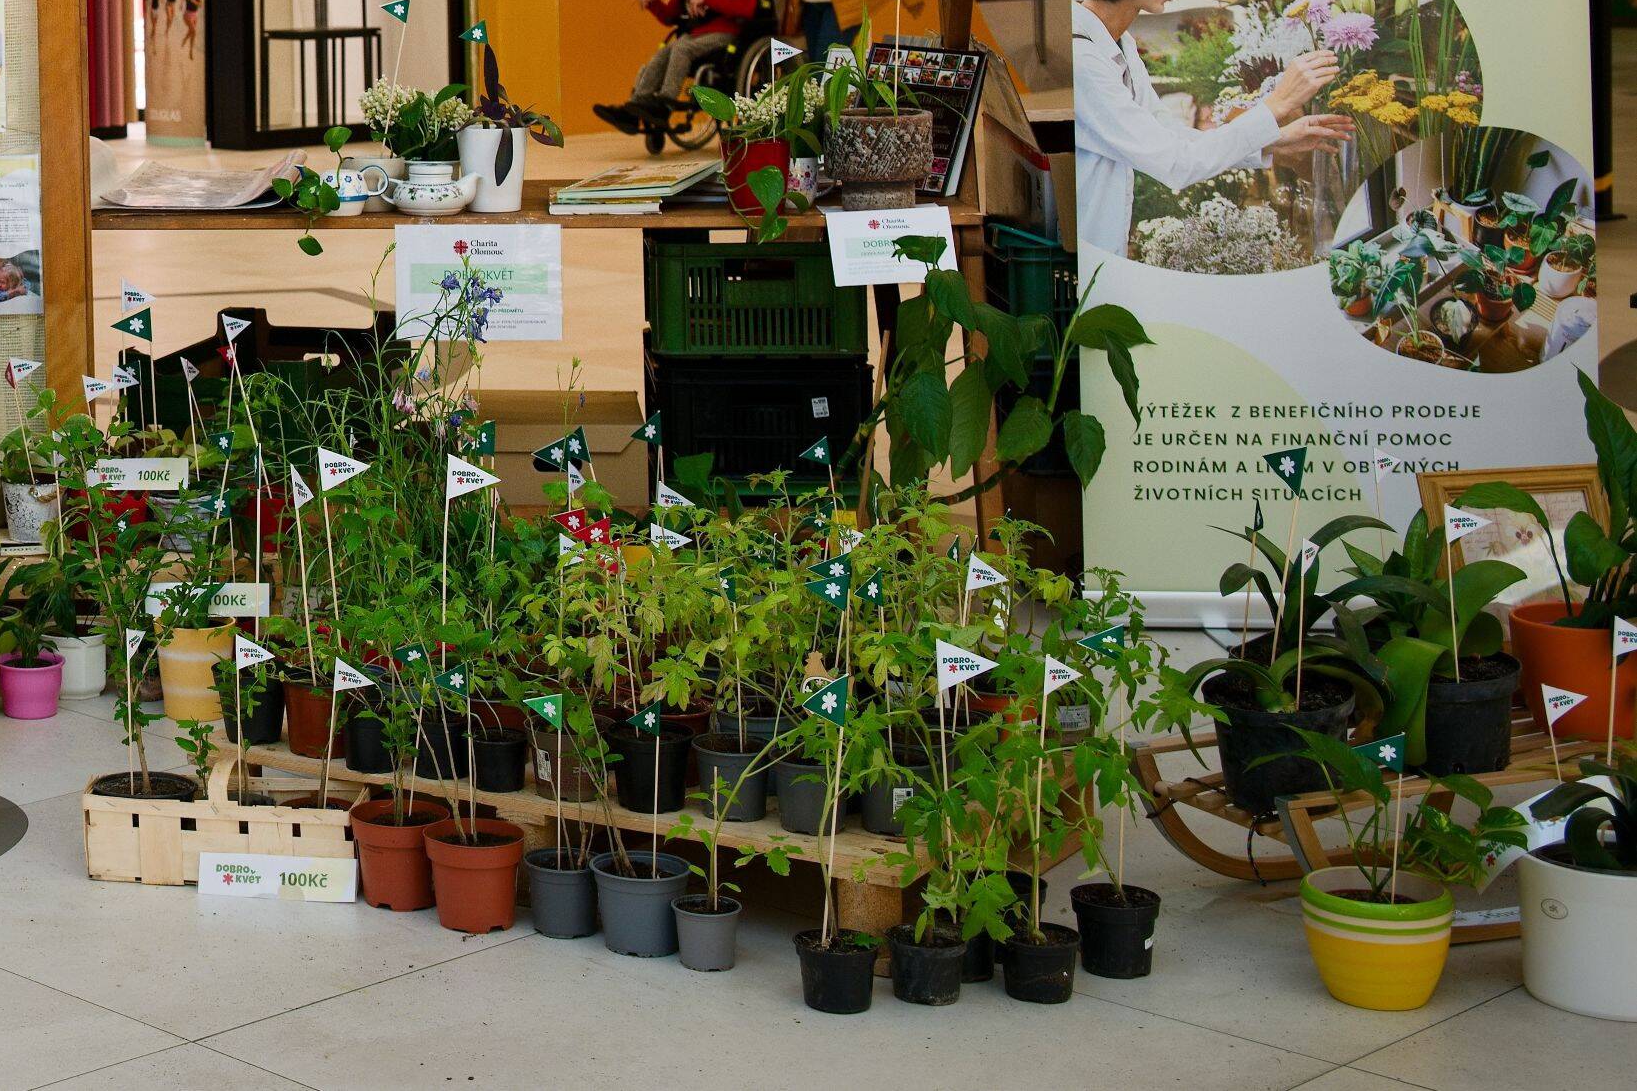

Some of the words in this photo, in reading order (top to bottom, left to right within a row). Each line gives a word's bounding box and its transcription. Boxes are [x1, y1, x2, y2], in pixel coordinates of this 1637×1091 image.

[470, 248, 504, 256] Olomouc
[1231, 405, 1241, 418] Z
[1250, 402, 1383, 418] BENEFIČNÍHO
[1392, 405, 1481, 418] PRODEJE
[1162, 430, 1228, 446] URČEN
[1236, 433, 1263, 446] NA
[1272, 430, 1369, 446] FINANČNÍ
[1377, 433, 1453, 446] POMOC
[1134, 457, 1227, 474] RODINÁM
[1235, 460, 1248, 473] A
[1322, 460, 1335, 473] V
[138, 470, 170, 481] 100Kč
[1134, 483, 1244, 502] ŽIVOTNÍCH
[279, 871, 328, 888] 100Kč
